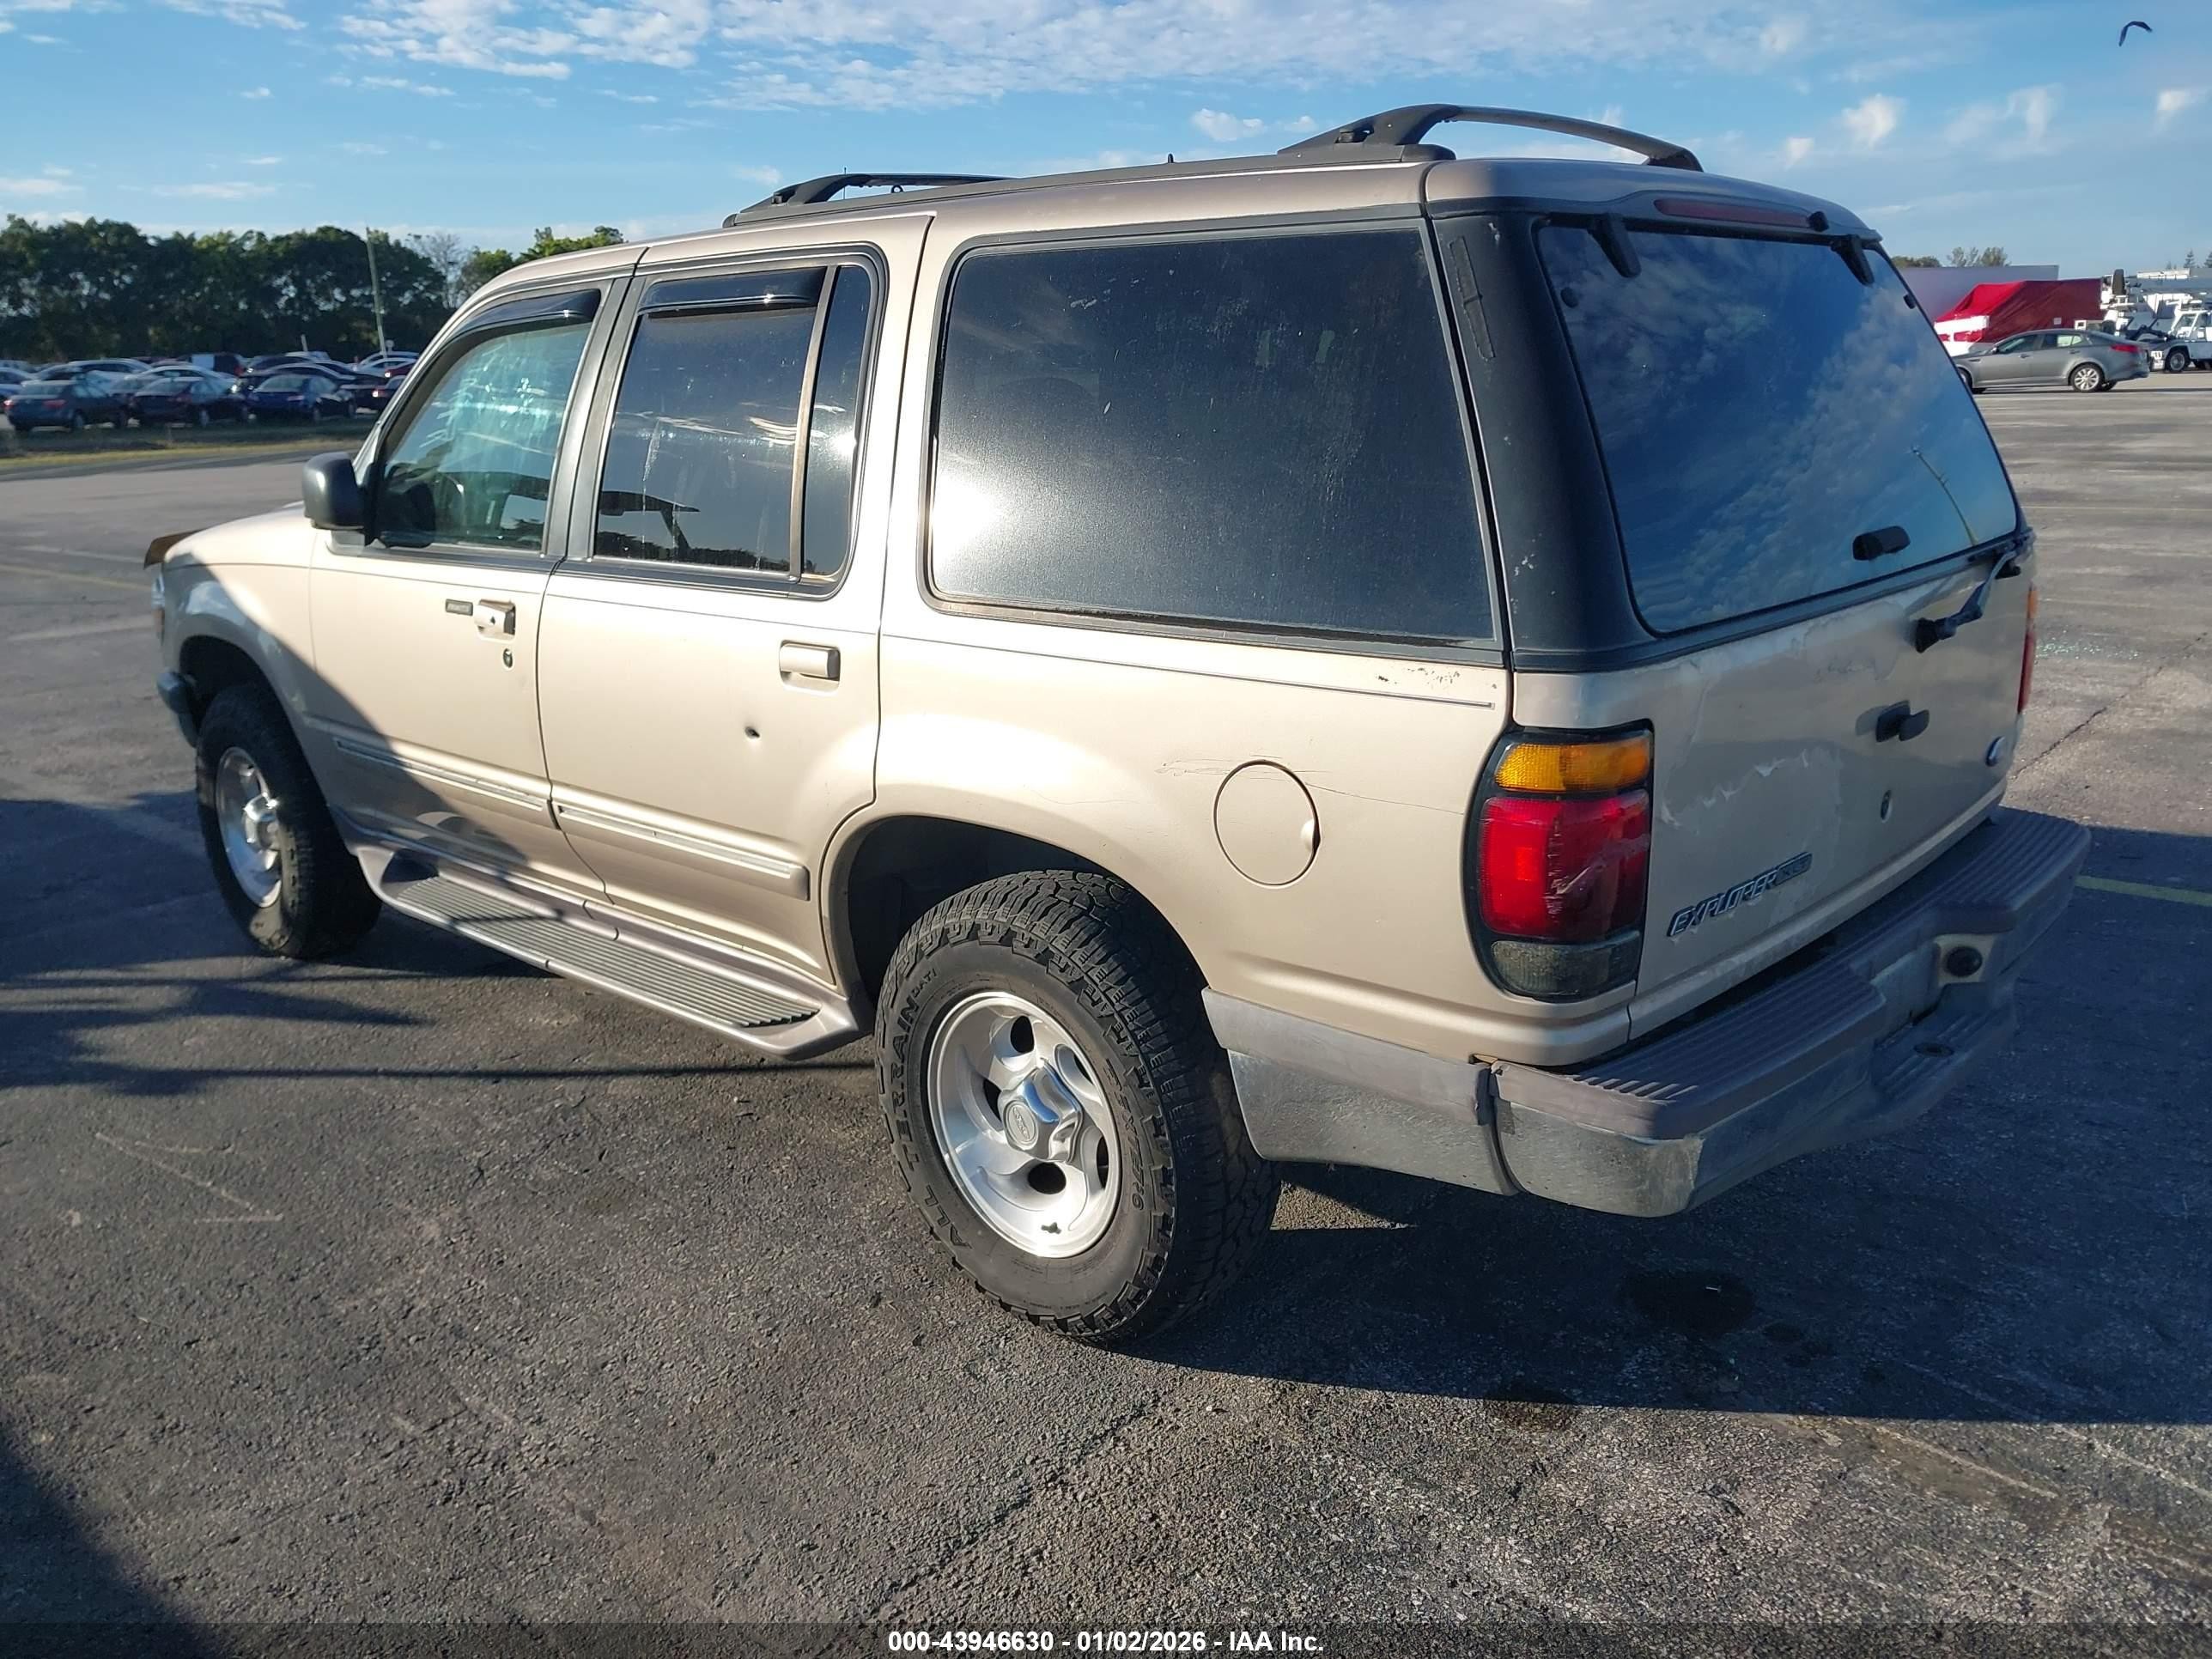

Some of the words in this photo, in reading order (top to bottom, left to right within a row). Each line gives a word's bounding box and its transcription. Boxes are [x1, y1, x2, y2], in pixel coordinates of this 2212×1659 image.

[1667, 867, 1778, 937] EXPLORER
[890, 994, 920, 1171] TERRAIN
[924, 1184, 972, 1249] ALL
